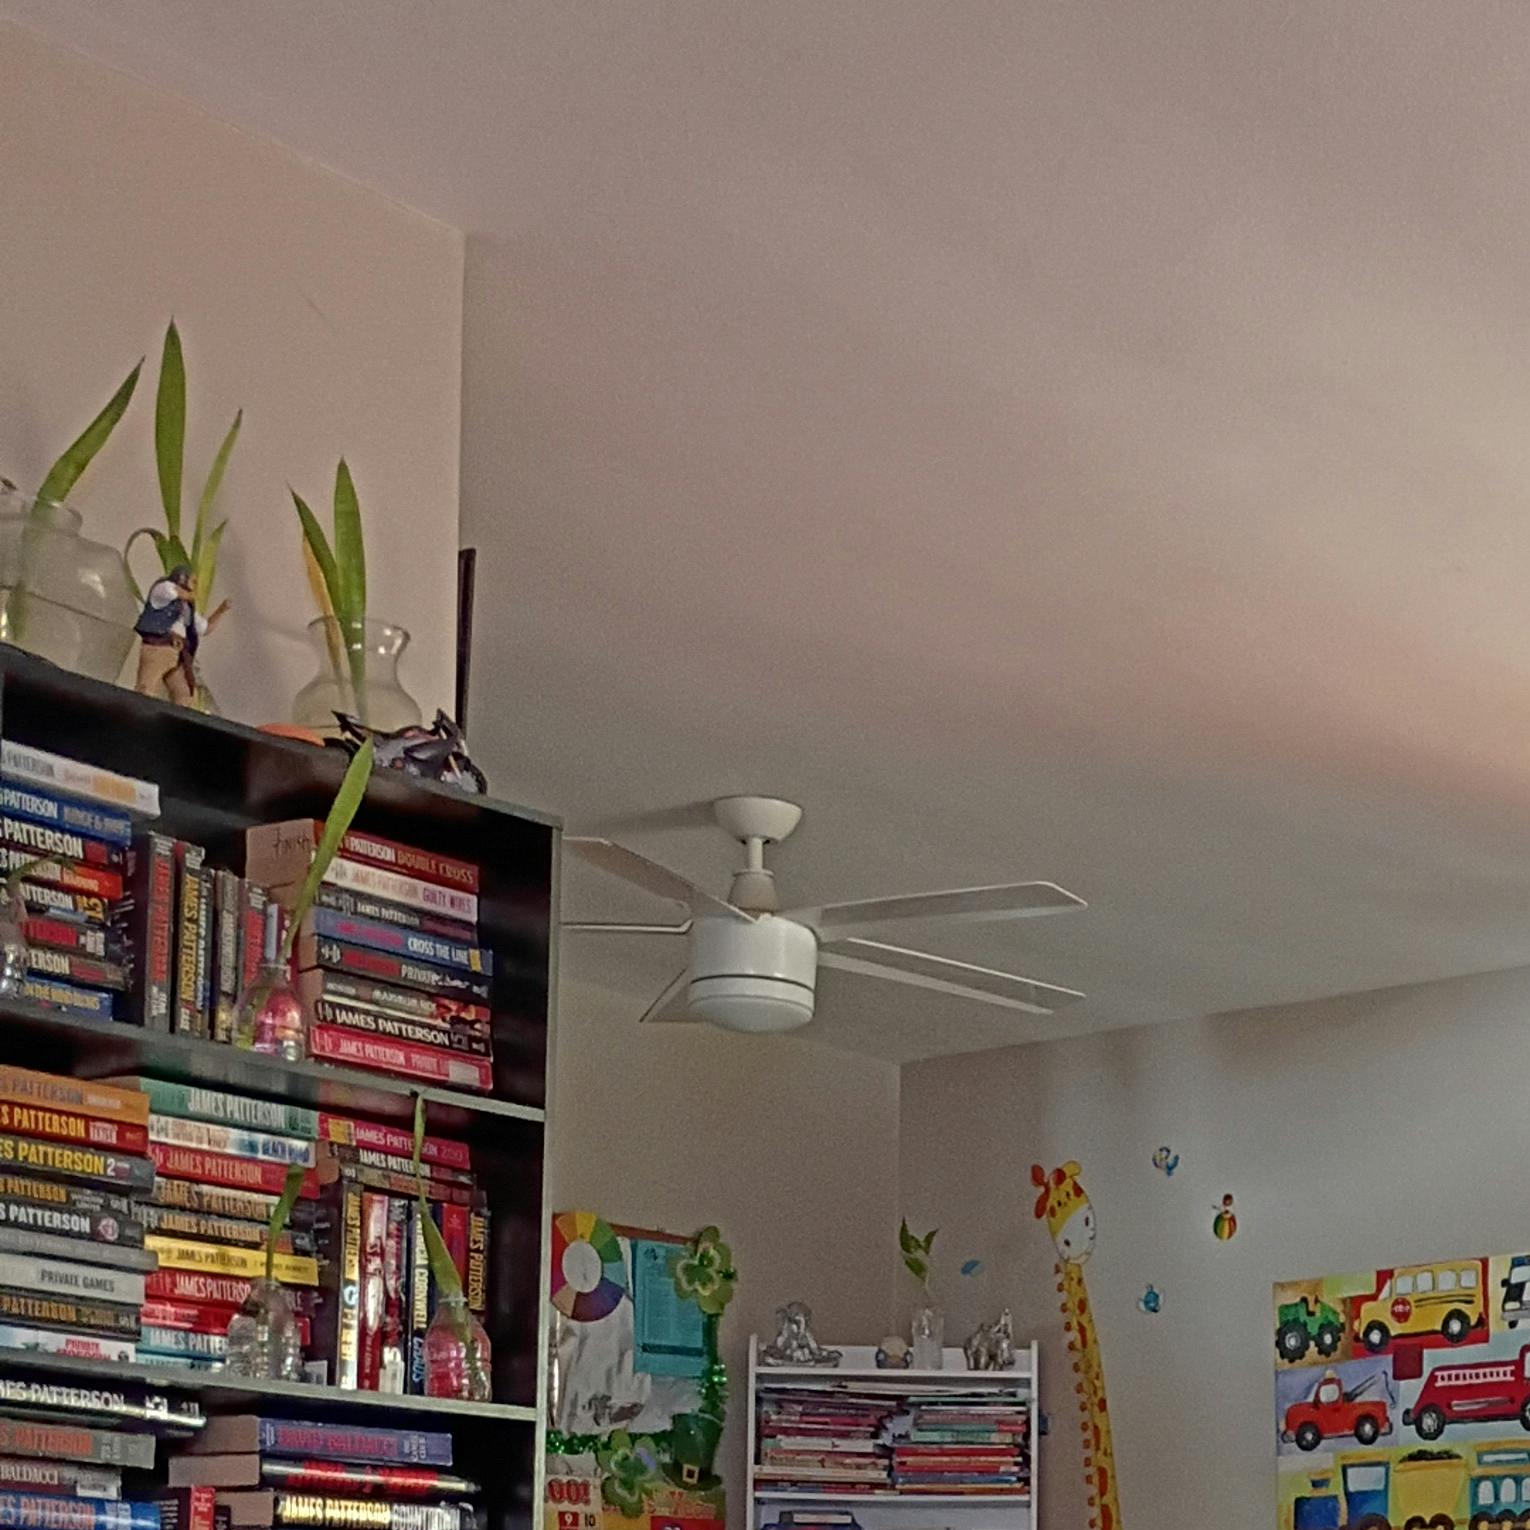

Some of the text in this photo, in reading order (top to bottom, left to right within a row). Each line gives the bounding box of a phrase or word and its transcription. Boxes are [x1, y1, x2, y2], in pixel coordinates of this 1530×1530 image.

[4, 817, 84, 859] PATTERSON
[438, 861, 475, 885] CROSS
[180, 872, 200, 1002] JAMES PATTERSON
[407, 936, 469, 965] CROSS THE LINE
[29, 948, 71, 975] ERSON
[335, 1007, 450, 1047] JAMES PATTERSON
[339, 1038, 363, 1058] JAMES
[364, 1043, 407, 1067] PATTERSON
[12, 1079, 84, 1105] PATTERSON
[13, 1106, 87, 1138] PATTERSON
[187, 1088, 287, 1131] JAMES PATTERSON
[356, 1127, 385, 1145] JAMES
[386, 1134, 439, 1156] PATTESON
[18, 1141, 116, 1177] PATTERSON 2
[167, 1150, 263, 1186] JAMES PATTERSON
[359, 1149, 387, 1168] JAMES
[6, 1177, 68, 1203] PATTERSON
[159, 1176, 200, 1209] JAMES
[203, 1192, 268, 1217] PATTERSON
[9, 1204, 91, 1234] PATTERSON
[160, 1213, 262, 1244] JAMES PATTERSON
[204, 1250, 249, 1270] PATTERSON
[468, 1216, 485, 1311] JAMES PATTERSON
[40, 1268, 115, 1293] PRIVATE GAMES
[174, 1273, 252, 1304] JAMES PATTERSO
[150, 1327, 186, 1351] JAMES
[31, 1383, 125, 1412] PATTERSON
[0, 1462, 59, 1485] BALDACCI
[283, 1495, 324, 1526] JAMES
[325, 1497, 391, 1530] PATTERSON
[564, 1513, 597, 1527] 9 10
